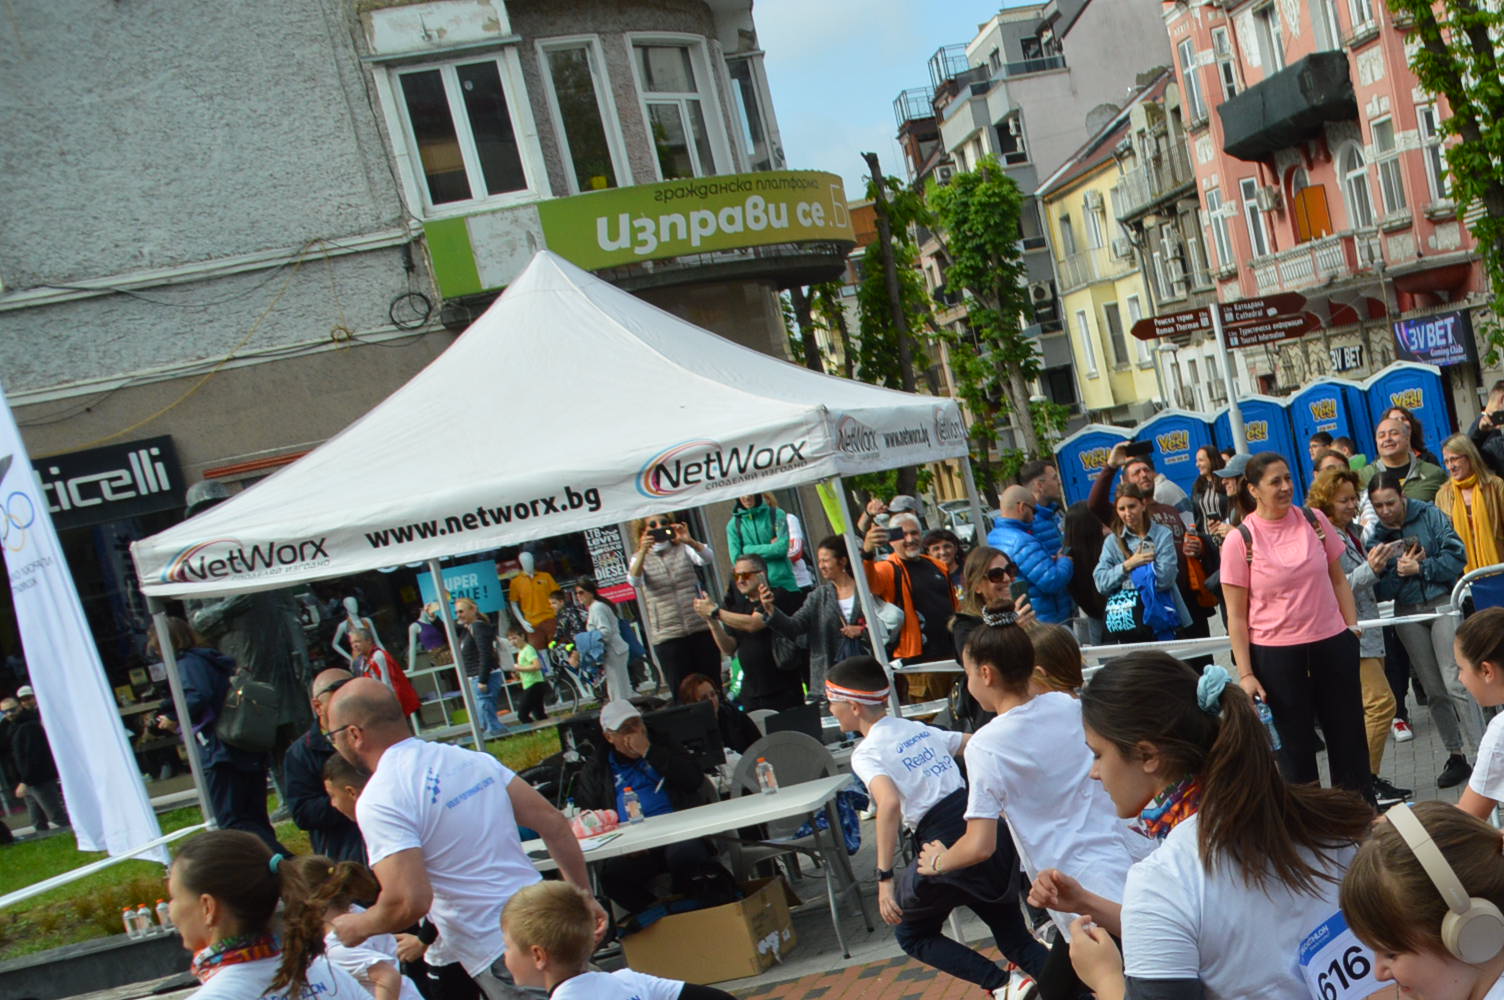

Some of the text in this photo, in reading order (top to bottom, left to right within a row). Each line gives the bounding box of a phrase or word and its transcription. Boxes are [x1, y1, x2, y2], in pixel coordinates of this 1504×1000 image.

[654, 179, 753, 203] гражданска
[654, 440, 807, 491] NetWorx
[365, 486, 602, 549] www.networx.bg
[182, 537, 330, 580] NetWorx
[443, 573, 479, 592] UPER
